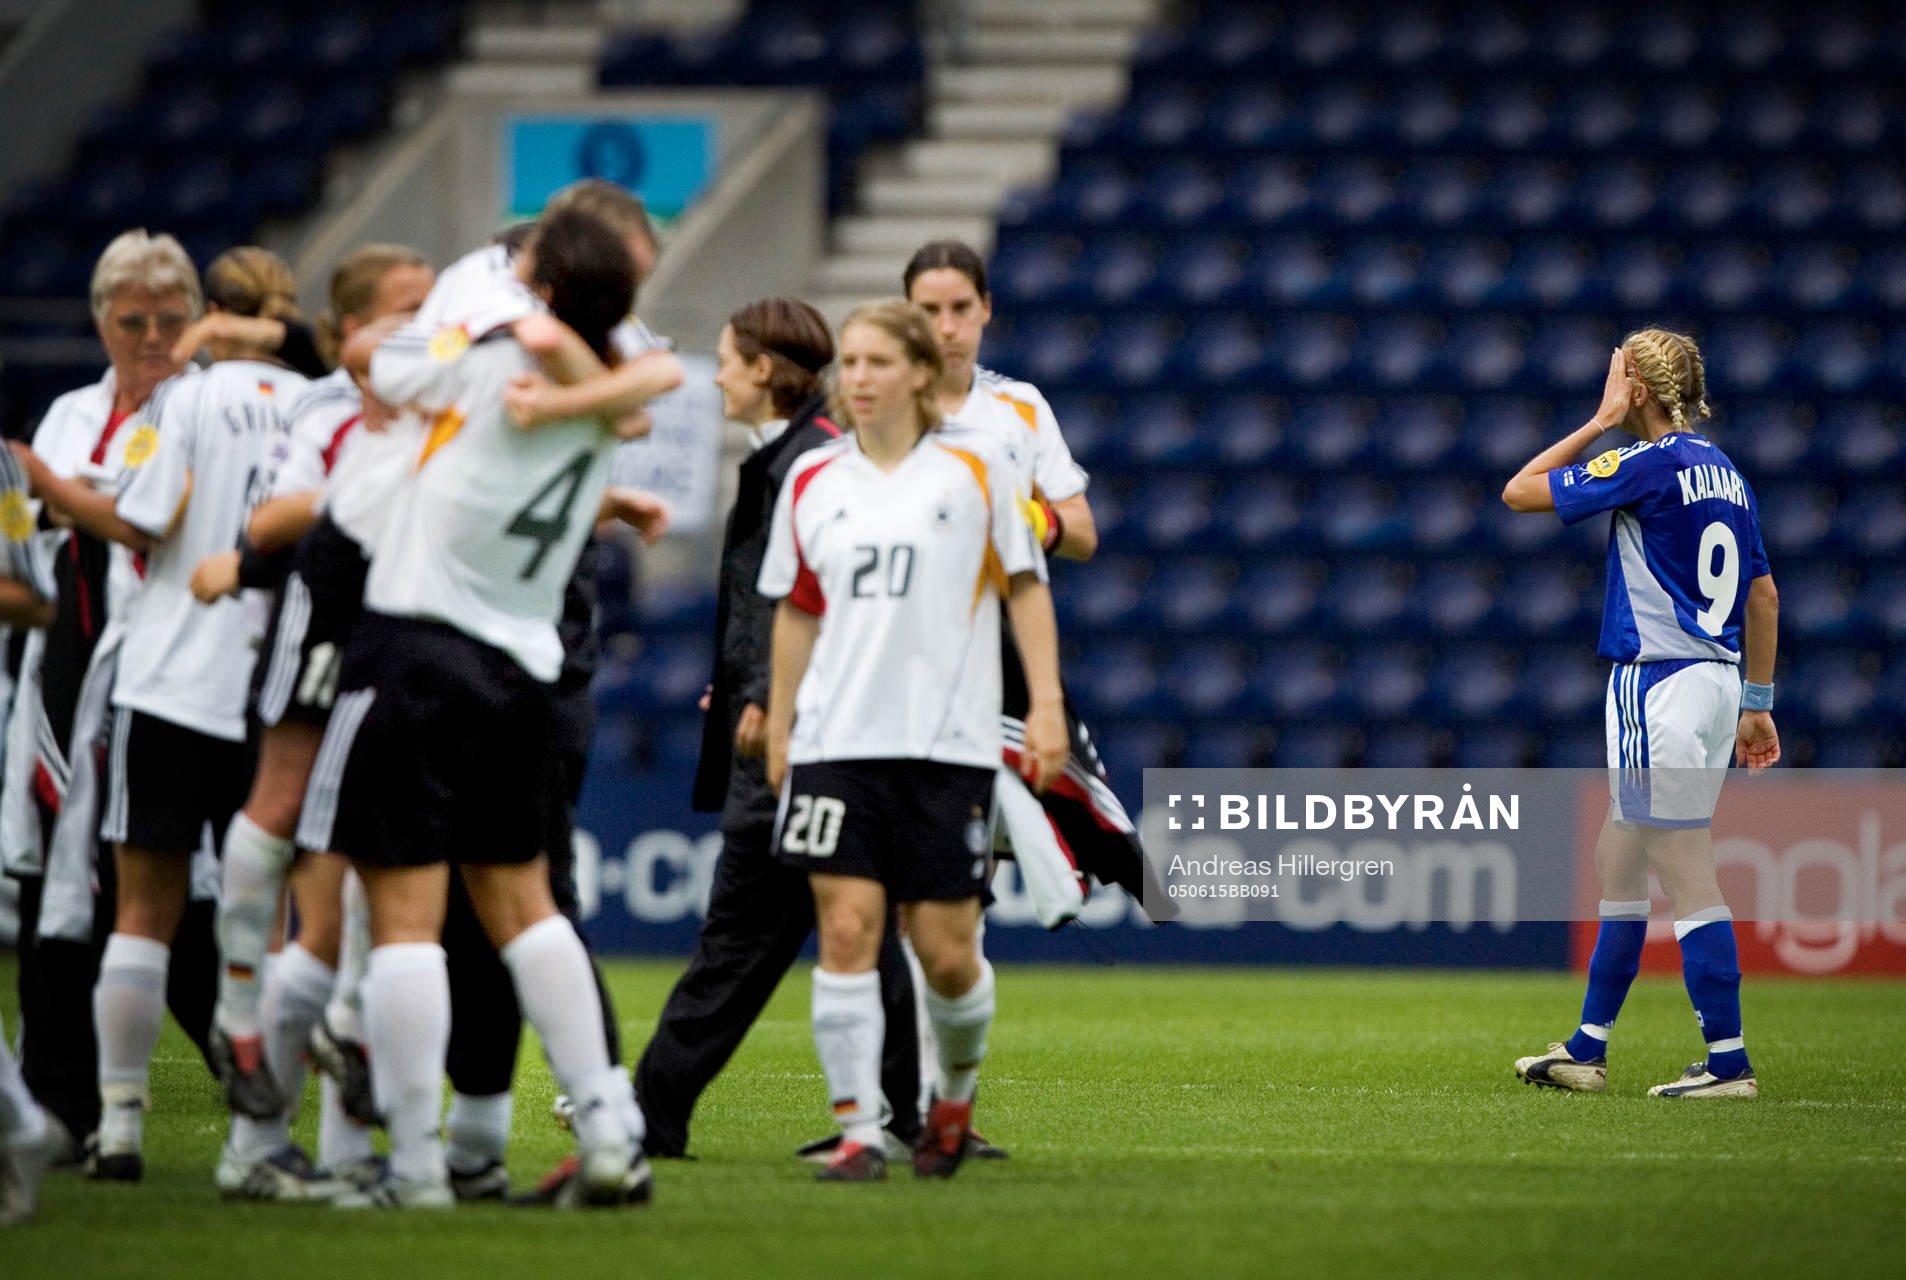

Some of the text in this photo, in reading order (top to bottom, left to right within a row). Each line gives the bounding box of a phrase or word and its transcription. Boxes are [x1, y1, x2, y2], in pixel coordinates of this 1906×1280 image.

[506, 449, 595, 579] 4
[1676, 463, 1749, 510] KALMARI
[851, 543, 915, 598] 20
[1697, 521, 1739, 636] 9
[782, 794, 846, 857] 20
